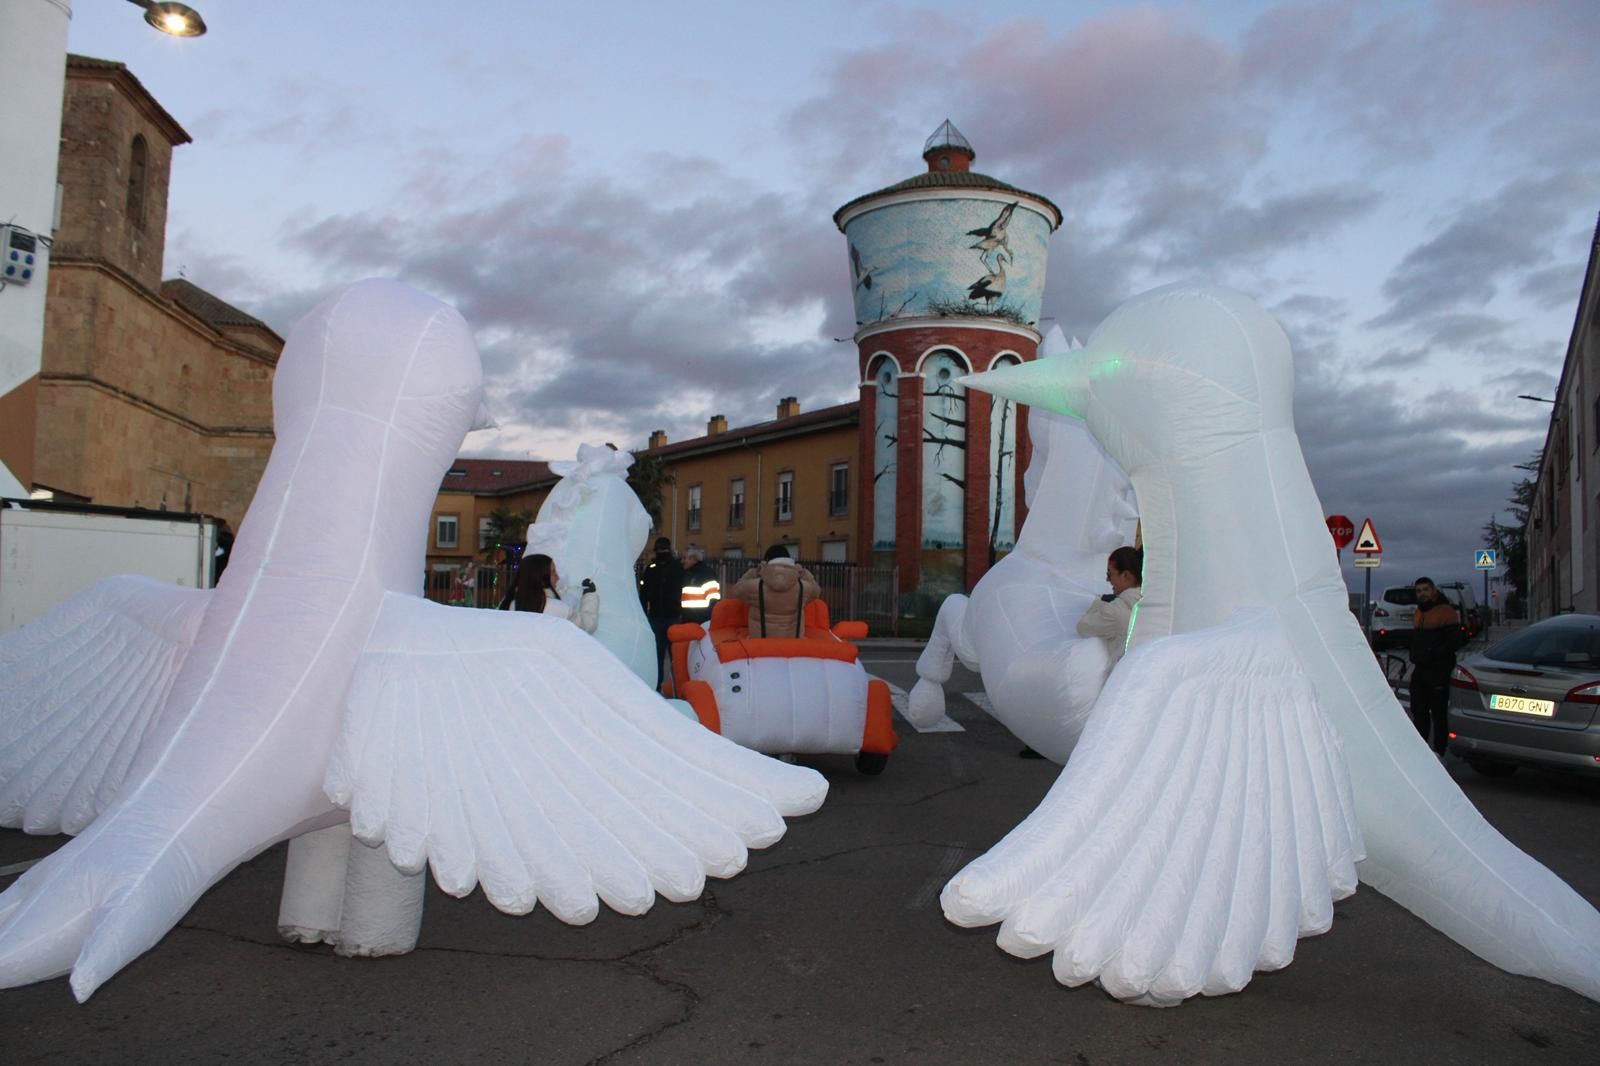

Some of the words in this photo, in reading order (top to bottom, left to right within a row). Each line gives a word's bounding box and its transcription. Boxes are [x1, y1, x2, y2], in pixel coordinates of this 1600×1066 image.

[1330, 527, 1352, 536] TOP
[1497, 697, 1525, 711] 8070
[1528, 700, 1550, 713] GNV
